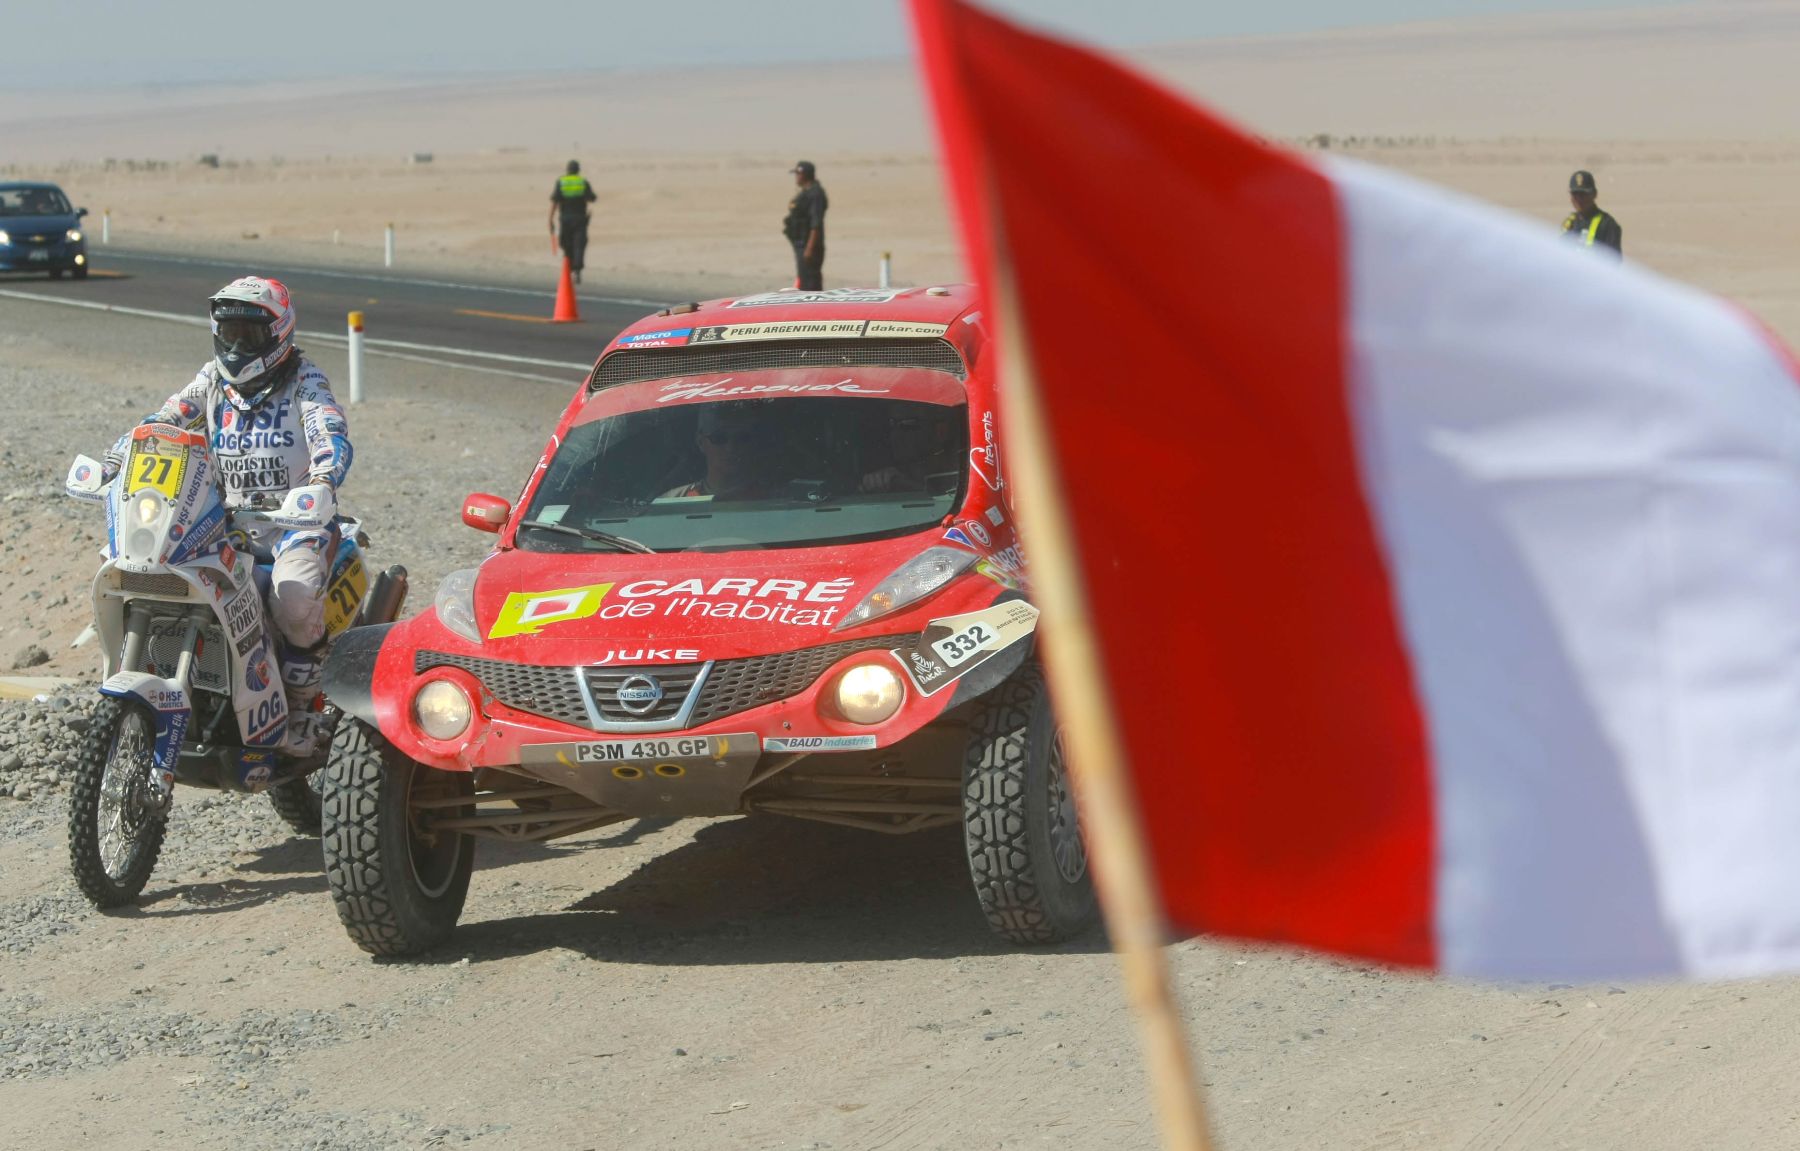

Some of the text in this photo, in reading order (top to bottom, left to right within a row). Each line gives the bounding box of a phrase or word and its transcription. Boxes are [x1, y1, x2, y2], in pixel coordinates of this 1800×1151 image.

[632, 332, 672, 341] Macro
[730, 324, 863, 336] PERU ARGENTINA CHILE
[871, 324, 945, 335] dakar.com
[626, 340, 669, 348] TOTAL
[139, 456, 173, 485] 27
[221, 470, 288, 490] FORCE
[177, 461, 207, 525] HSF LOGISTICS
[331, 578, 360, 617] 27
[618, 578, 855, 602] CARRÉ
[600, 598, 838, 626] de l'habitat
[996, 612, 1033, 630] ARGENTINA
[942, 626, 991, 660] 332
[592, 649, 700, 665] JUKE
[166, 691, 182, 702] HSF
[172, 713, 184, 728] Elk
[169, 731, 179, 746] van
[789, 737, 874, 748] BAUD industries
[160, 747, 175, 769] Koos
[577, 739, 707, 760] PSM 430 GP
